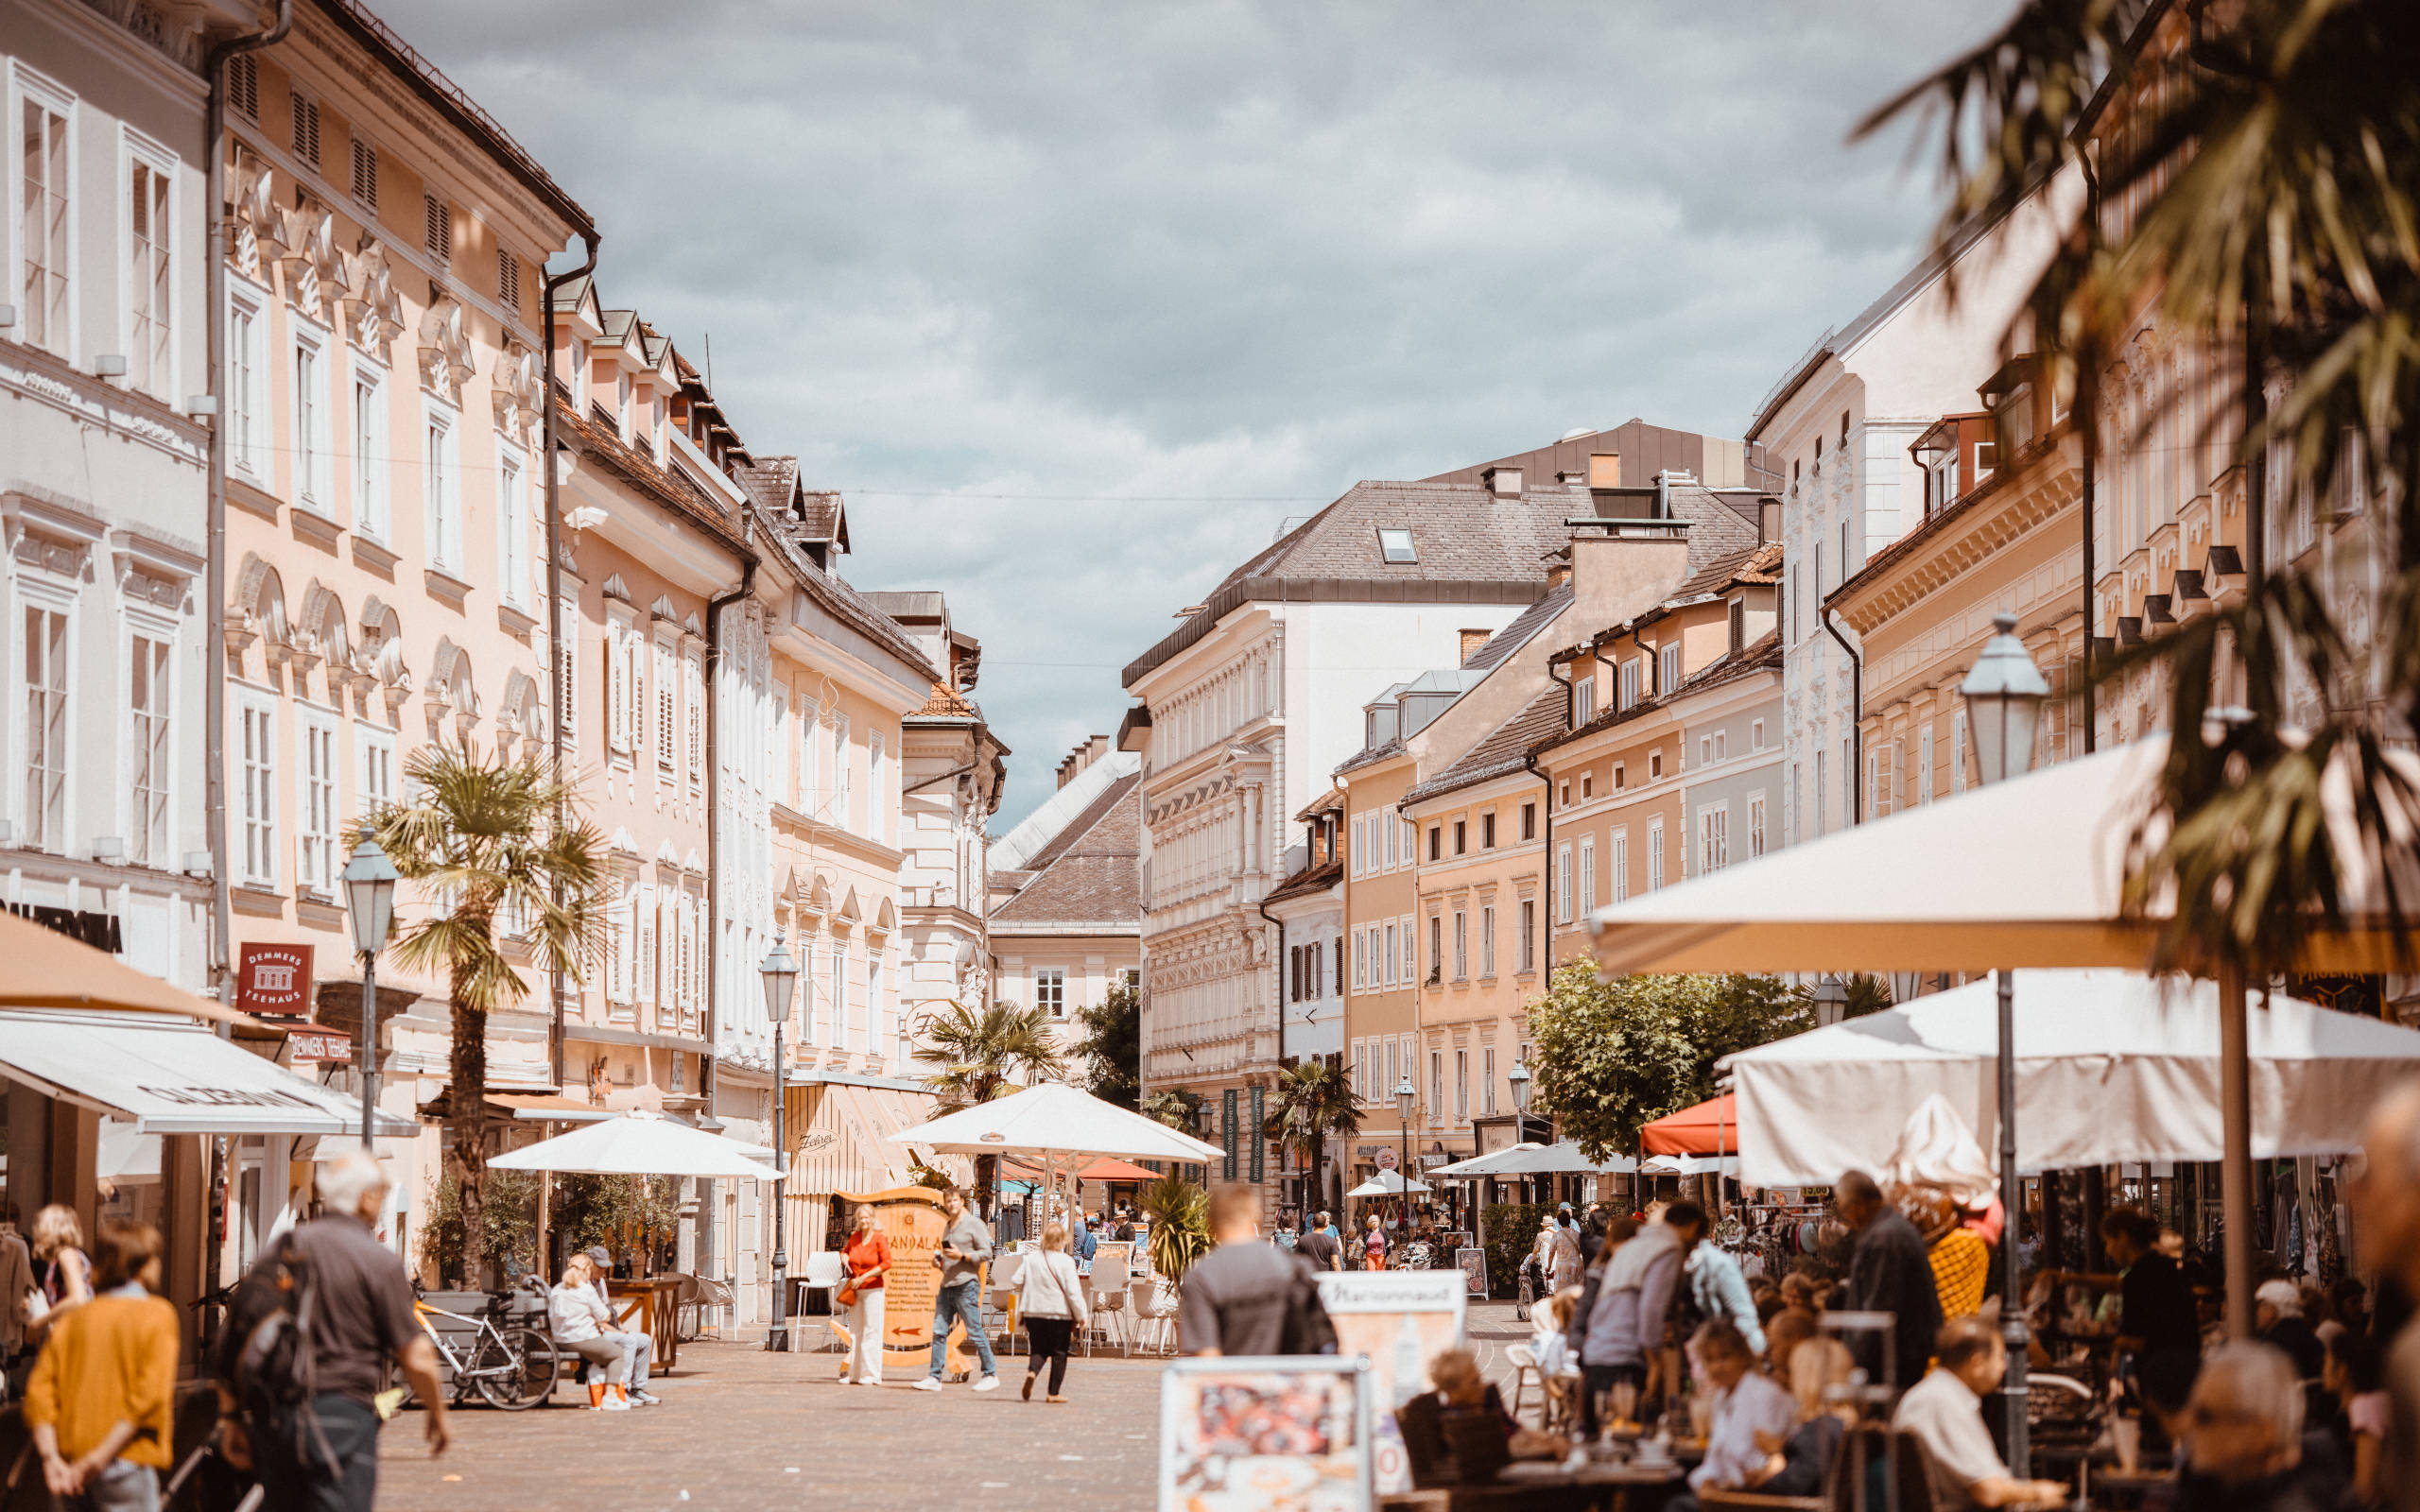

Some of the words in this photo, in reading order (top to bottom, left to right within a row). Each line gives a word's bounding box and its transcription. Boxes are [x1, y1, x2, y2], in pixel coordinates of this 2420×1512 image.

[248, 952, 302, 966] DEMMERS
[245, 988, 301, 1004] TEEHAUS
[290, 1035, 325, 1057] DEMMERS
[325, 1038, 351, 1058] TEEHAUS
[1227, 1125, 1234, 1133] OF
[886, 1234, 942, 1253] ANDALA
